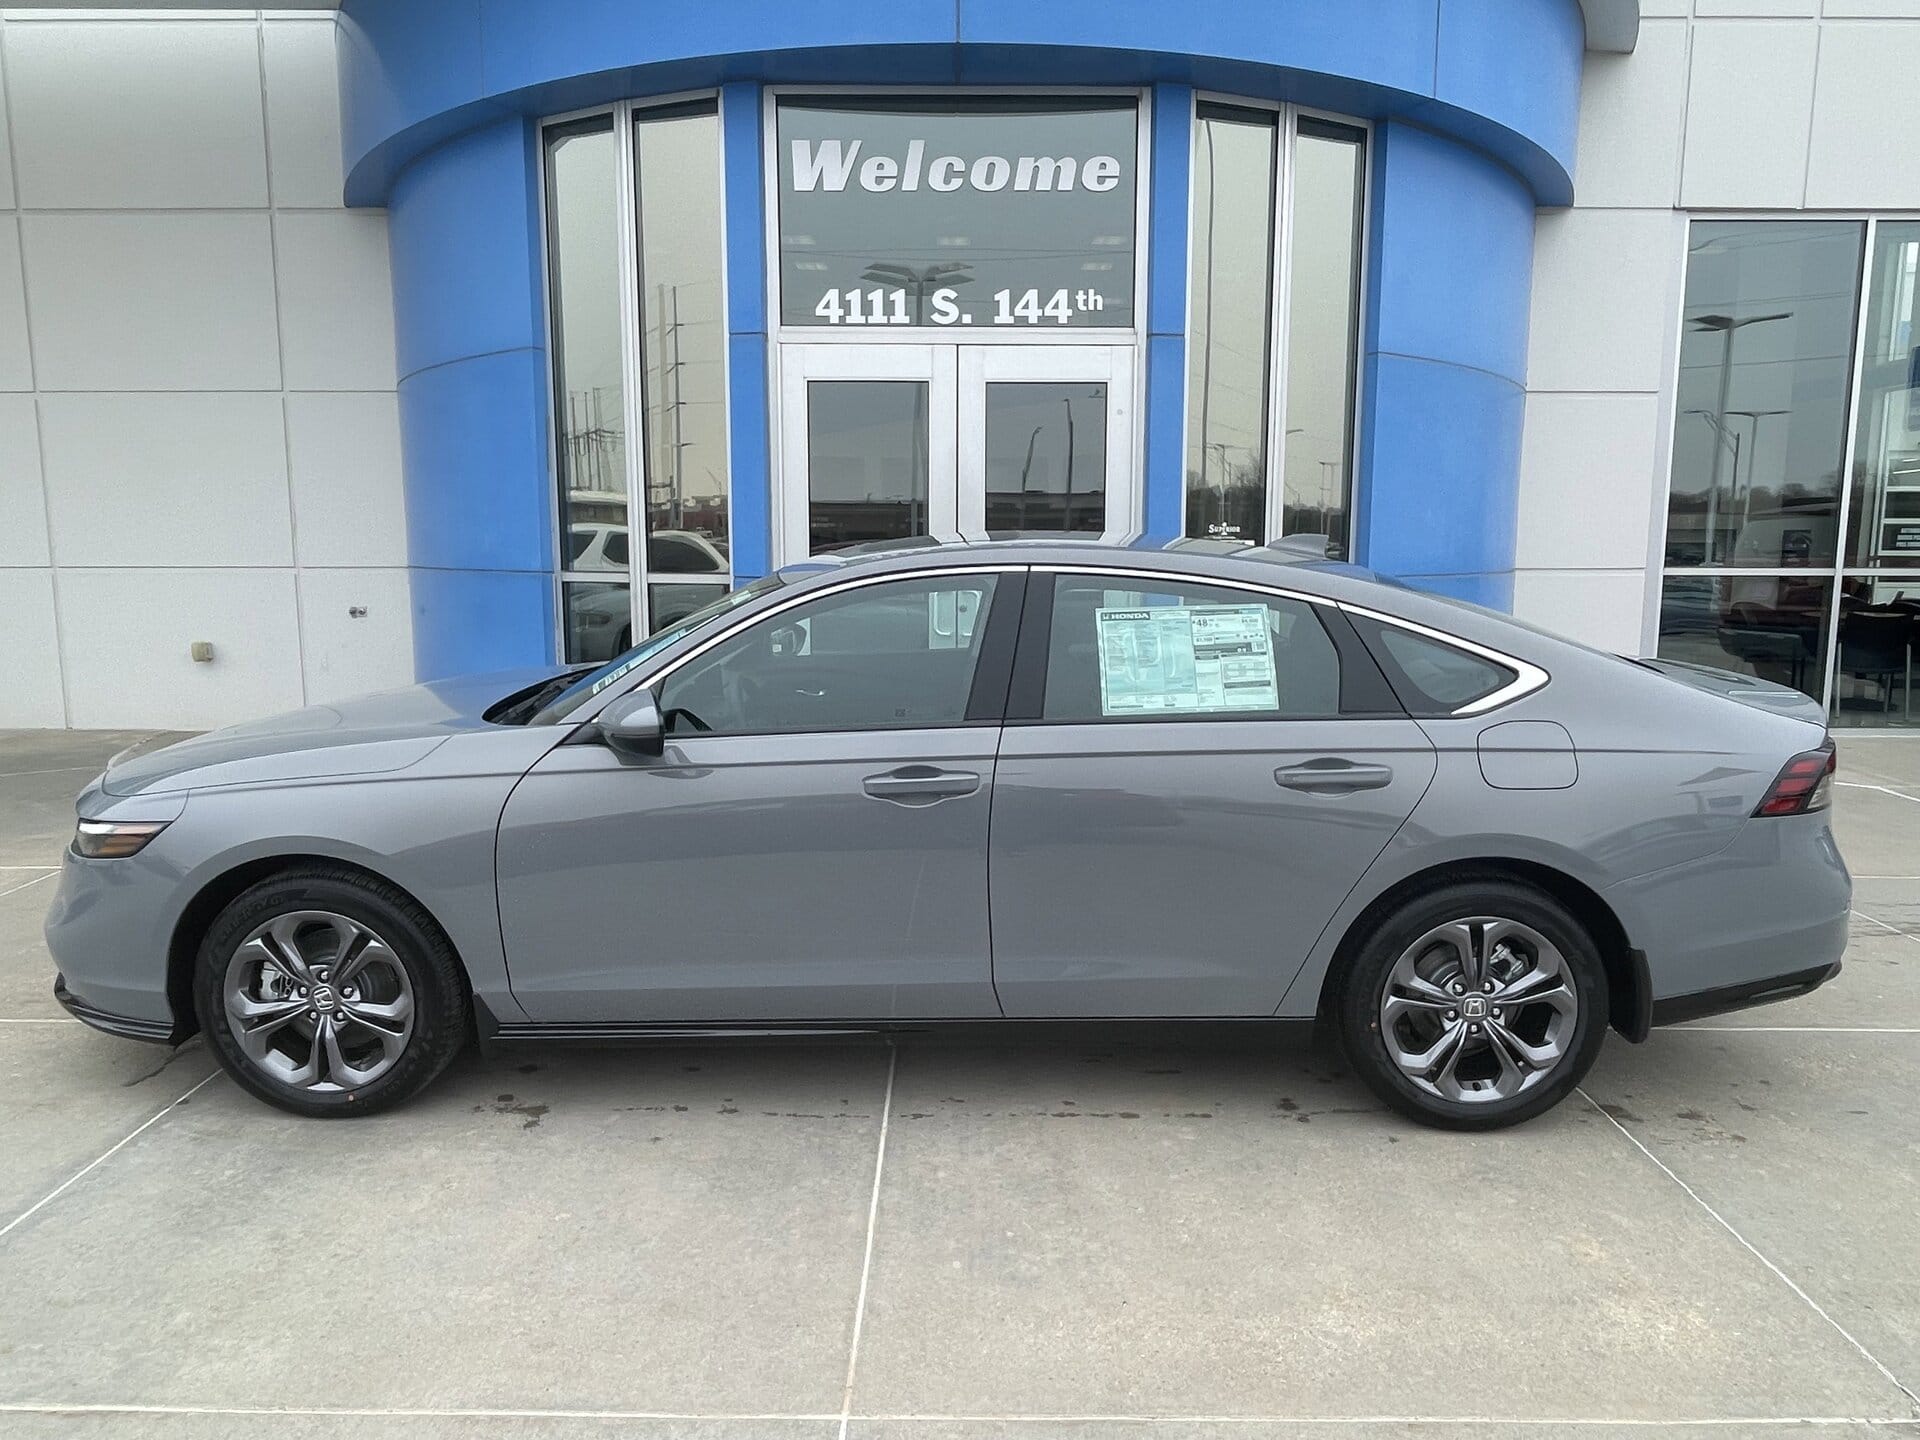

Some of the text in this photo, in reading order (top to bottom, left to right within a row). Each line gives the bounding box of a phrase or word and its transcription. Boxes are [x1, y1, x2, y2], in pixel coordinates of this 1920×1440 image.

[791, 139, 1121, 192] Welcome
[815, 288, 1104, 325] 4111 S. 144th
[1111, 612, 1150, 620] HONDA
